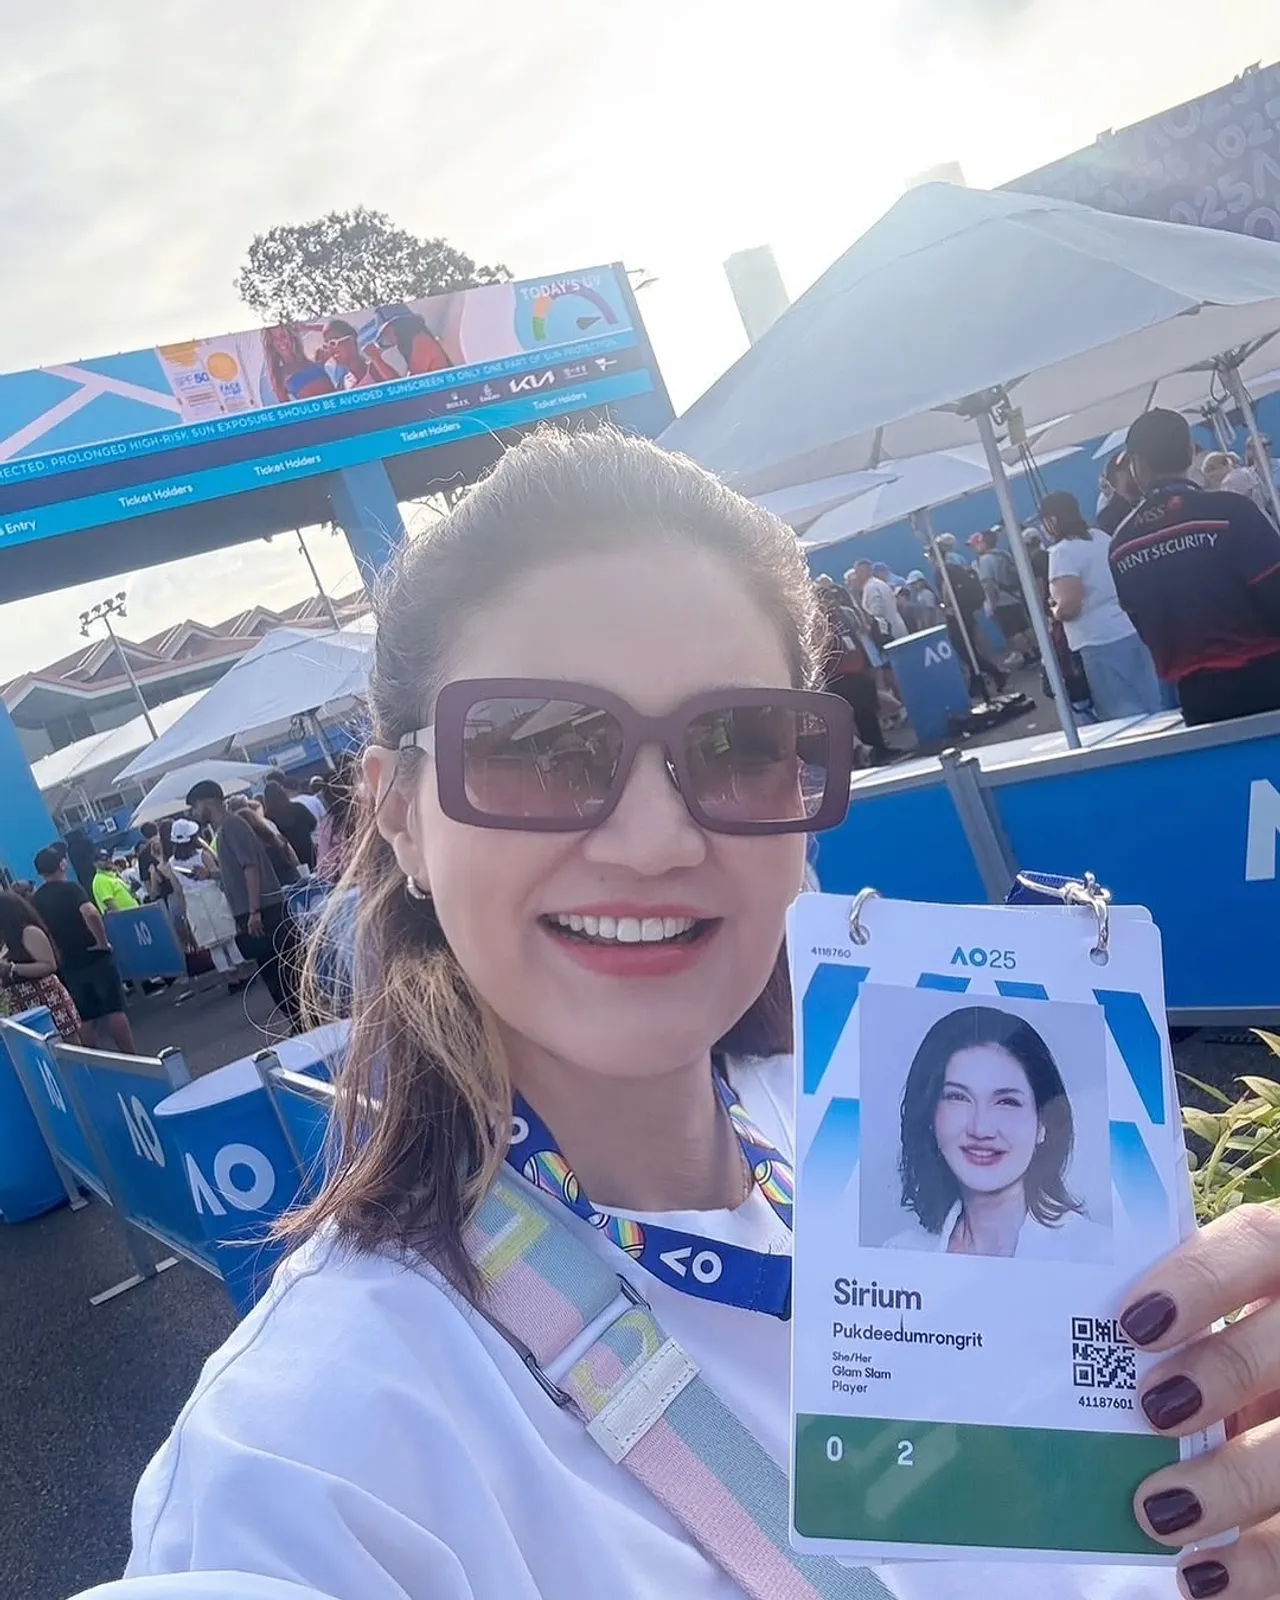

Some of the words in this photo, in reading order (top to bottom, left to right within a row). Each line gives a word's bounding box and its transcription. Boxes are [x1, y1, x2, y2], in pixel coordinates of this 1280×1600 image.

[509, 370, 556, 394] KIA
[50, 441, 128, 468] PROLONGED
[190, 423, 215, 438] SUN
[217, 410, 277, 433] EXPOSURE
[277, 403, 321, 421] SHOULD
[322, 398, 338, 411] BE
[387, 376, 445, 397] SUNSCREEN
[399, 428, 429, 442] Ticket
[428, 422, 462, 437] Holders
[253, 463, 285, 477] Ticket
[285, 454, 322, 469] Holders
[118, 494, 153, 509] Ticket
[153, 484, 194, 501] Holders
[5, 519, 37, 535] Entry
[1150, 532, 1219, 560] SECURITY
[811, 946, 852, 960] 4118760
[950, 946, 1017, 969] AO25
[833, 1277, 923, 1311] Sirium
[832, 1321, 984, 1351] Pukdeedumrongrit
[831, 1350, 873, 1364] She/Her
[831, 1365, 863, 1378] Glam
[864, 1366, 892, 1380] Slam
[831, 1379, 869, 1396] Player
[1078, 1396, 1134, 1411] 41187601
[897, 1440, 914, 1467] 2
